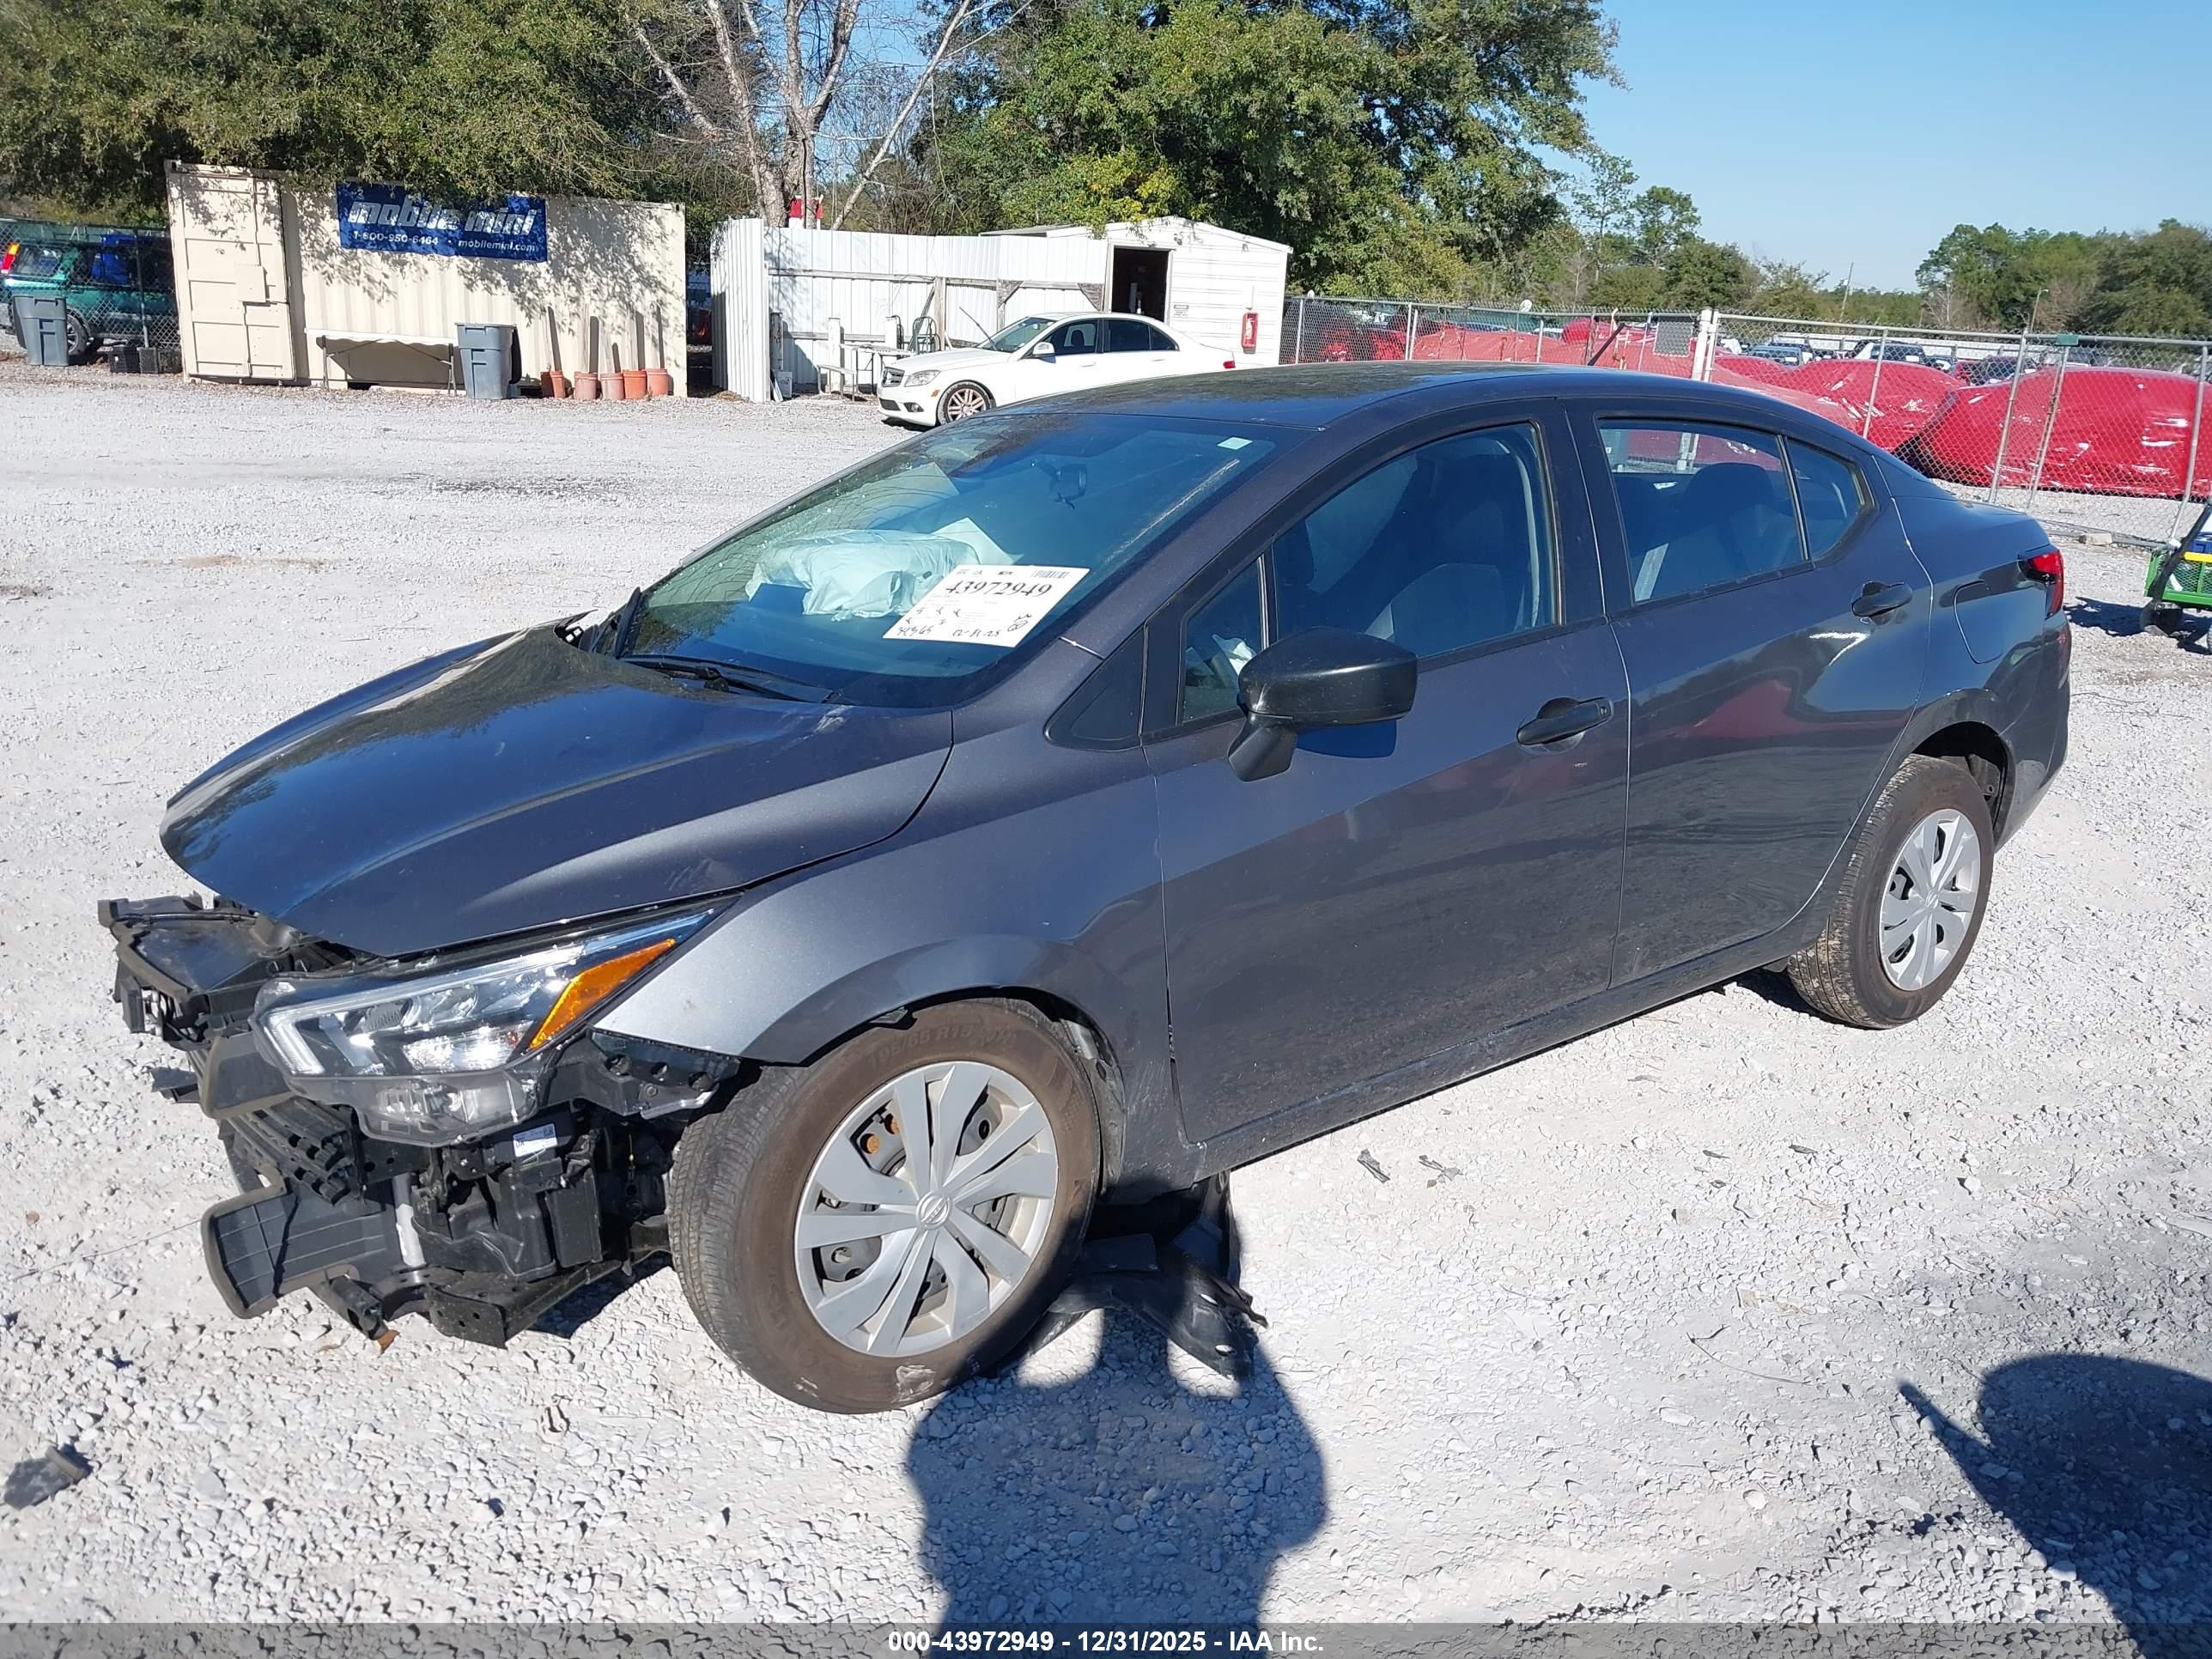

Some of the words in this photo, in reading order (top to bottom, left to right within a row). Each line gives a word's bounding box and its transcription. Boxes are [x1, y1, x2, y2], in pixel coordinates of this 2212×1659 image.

[348, 196, 459, 230] mobile
[465, 208, 537, 234] mini
[354, 231, 439, 246] 1-800-950-6464
[458, 238, 537, 252] mobilemini.com
[946, 580, 1052, 597] 43972949
